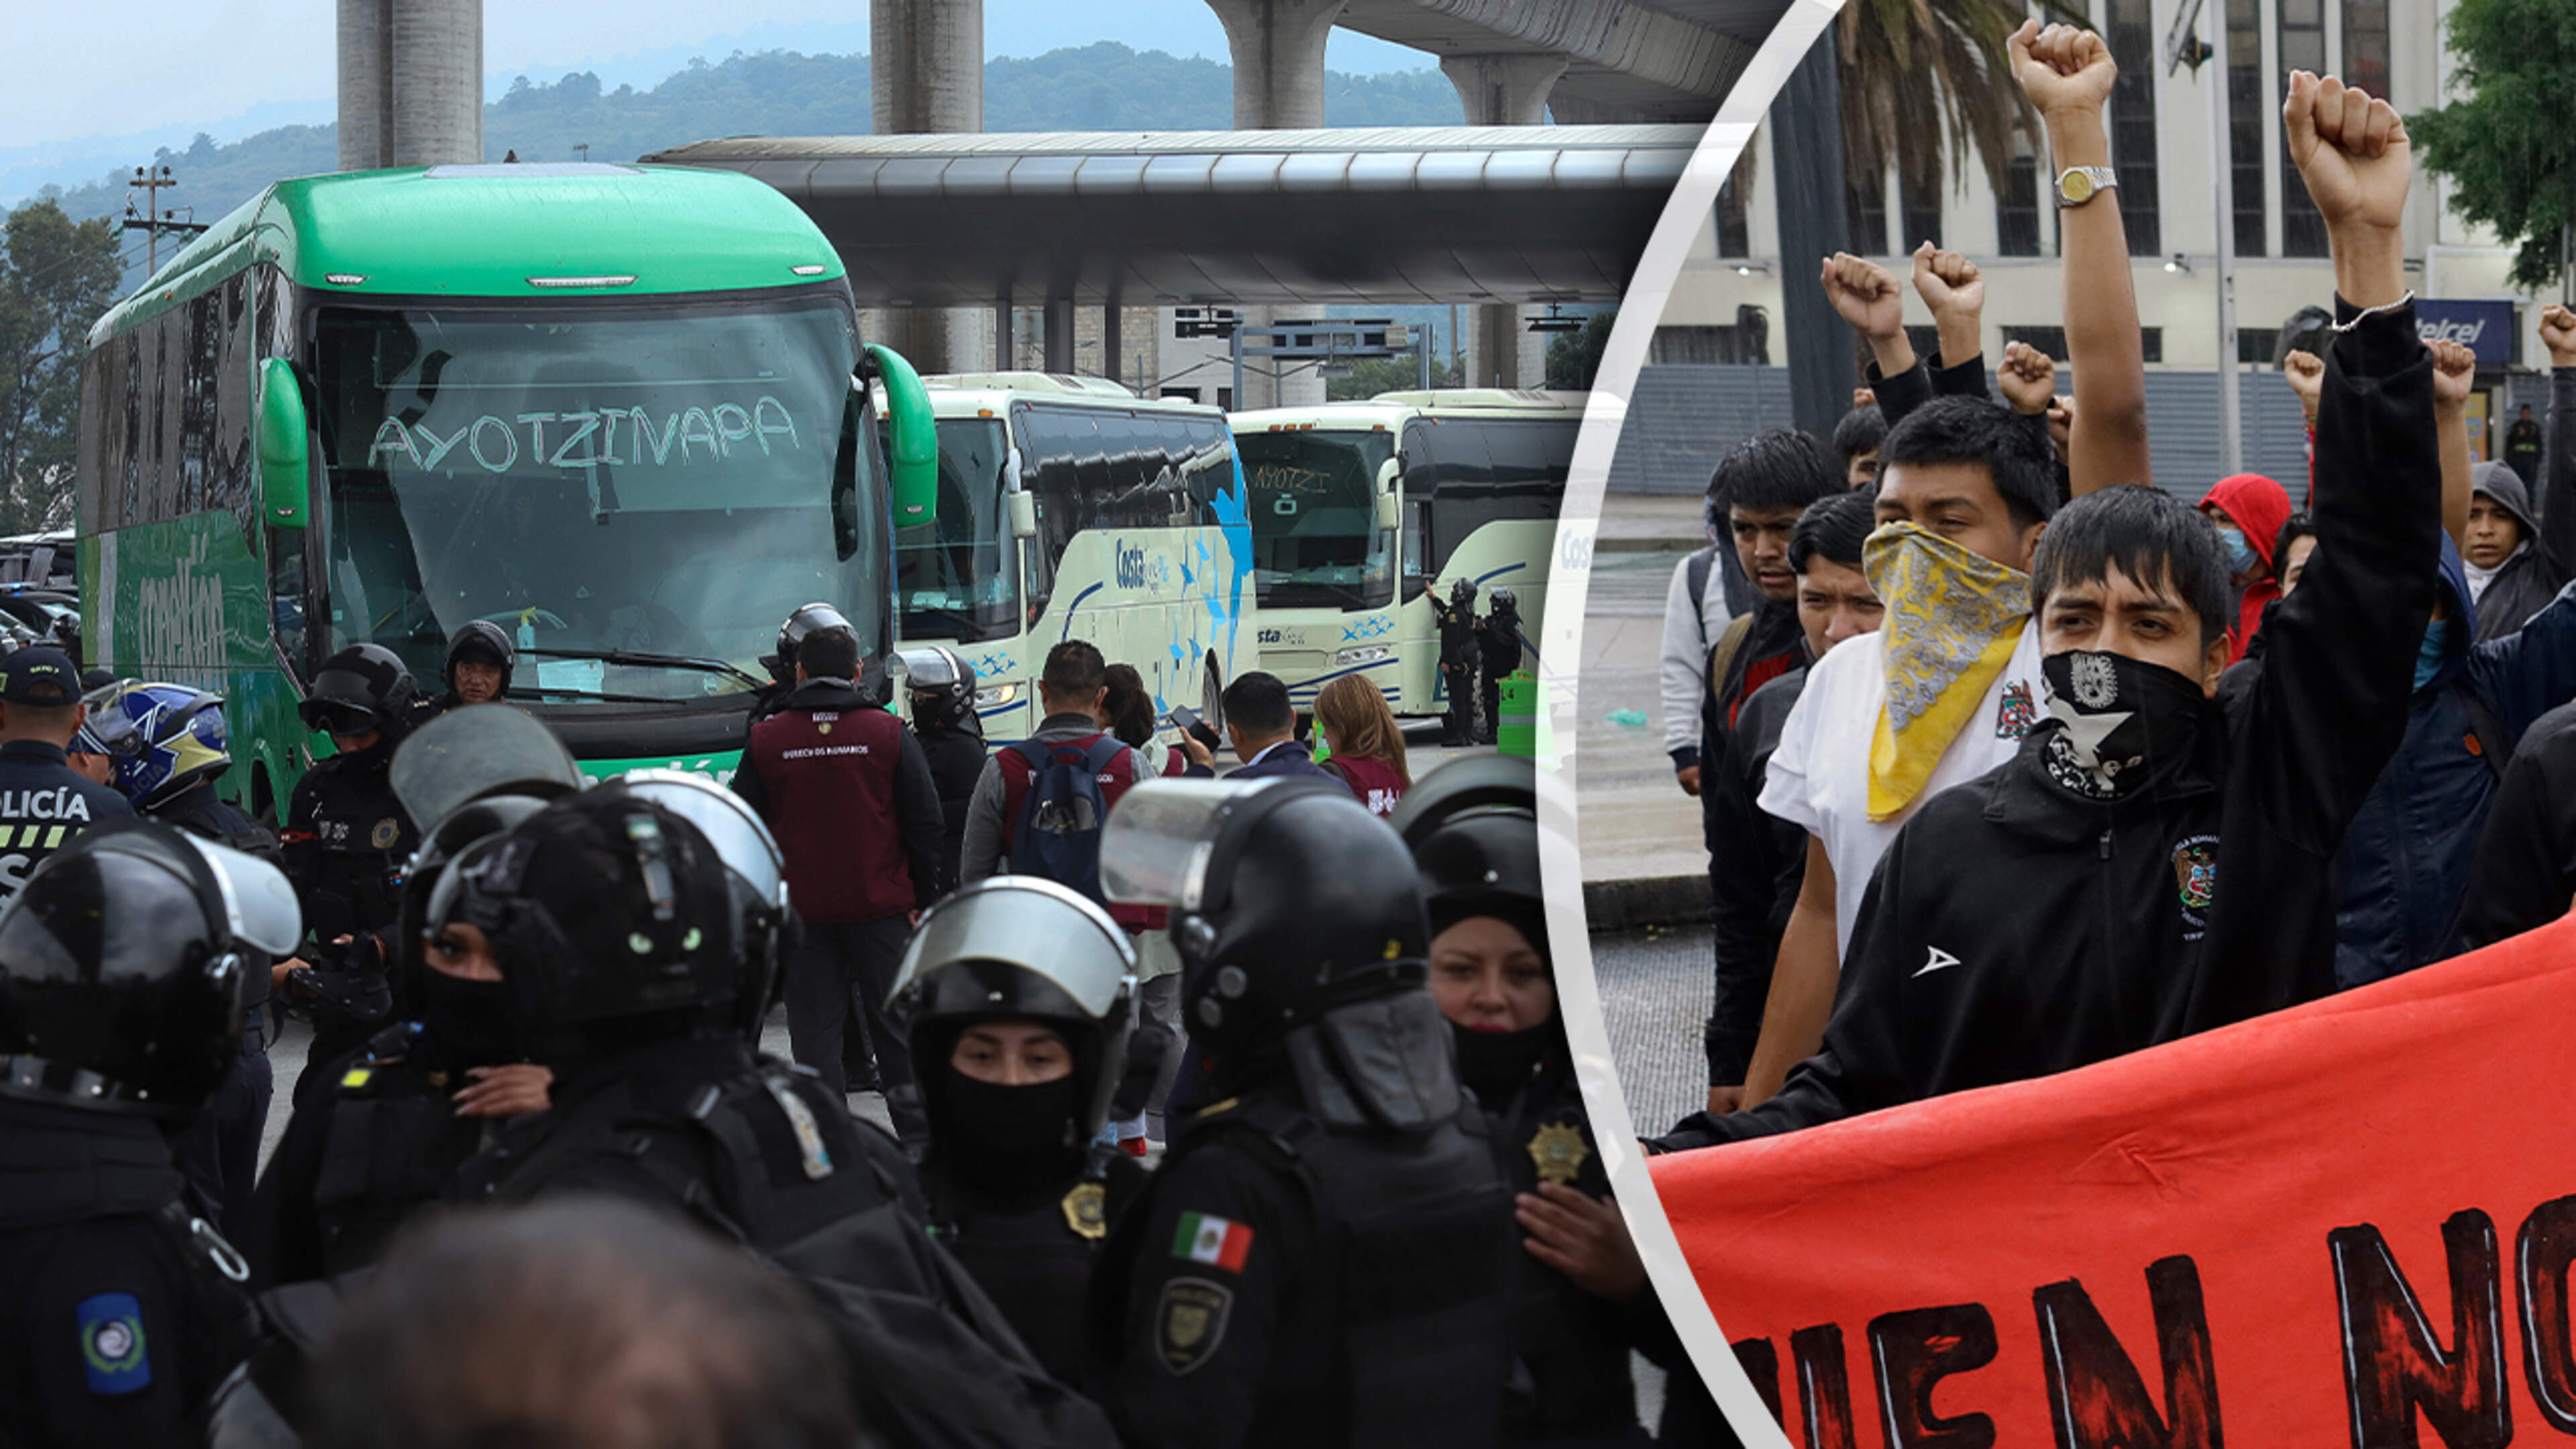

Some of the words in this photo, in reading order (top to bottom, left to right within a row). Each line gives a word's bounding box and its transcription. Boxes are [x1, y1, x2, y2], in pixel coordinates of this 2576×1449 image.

[368, 395, 800, 473] AYOTZINAPA
[1255, 466, 1331, 494] AYOTZI
[1116, 538, 1144, 589] Costa
[1561, 529, 1595, 570] Cos
[1257, 629, 1280, 643] sta
[0, 786, 91, 822] LICÍA
[1734, 1253, 2224, 1449] IEN
